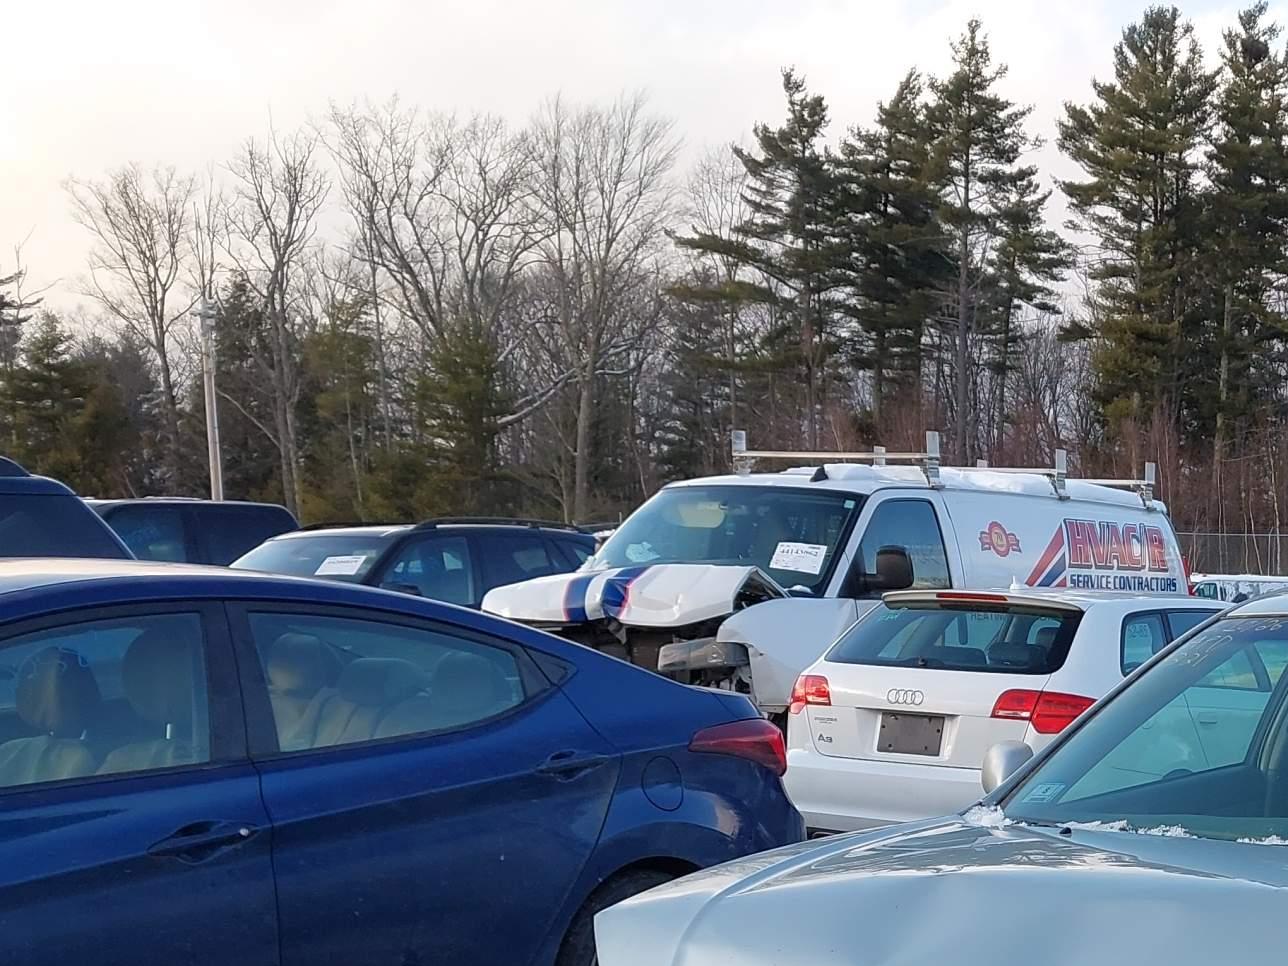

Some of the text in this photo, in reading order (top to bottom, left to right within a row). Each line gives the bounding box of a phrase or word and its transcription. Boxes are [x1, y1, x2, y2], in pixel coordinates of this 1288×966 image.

[1069, 574, 1177, 592] SERVICE CONTRACTORS
[818, 734, 833, 743] A3
